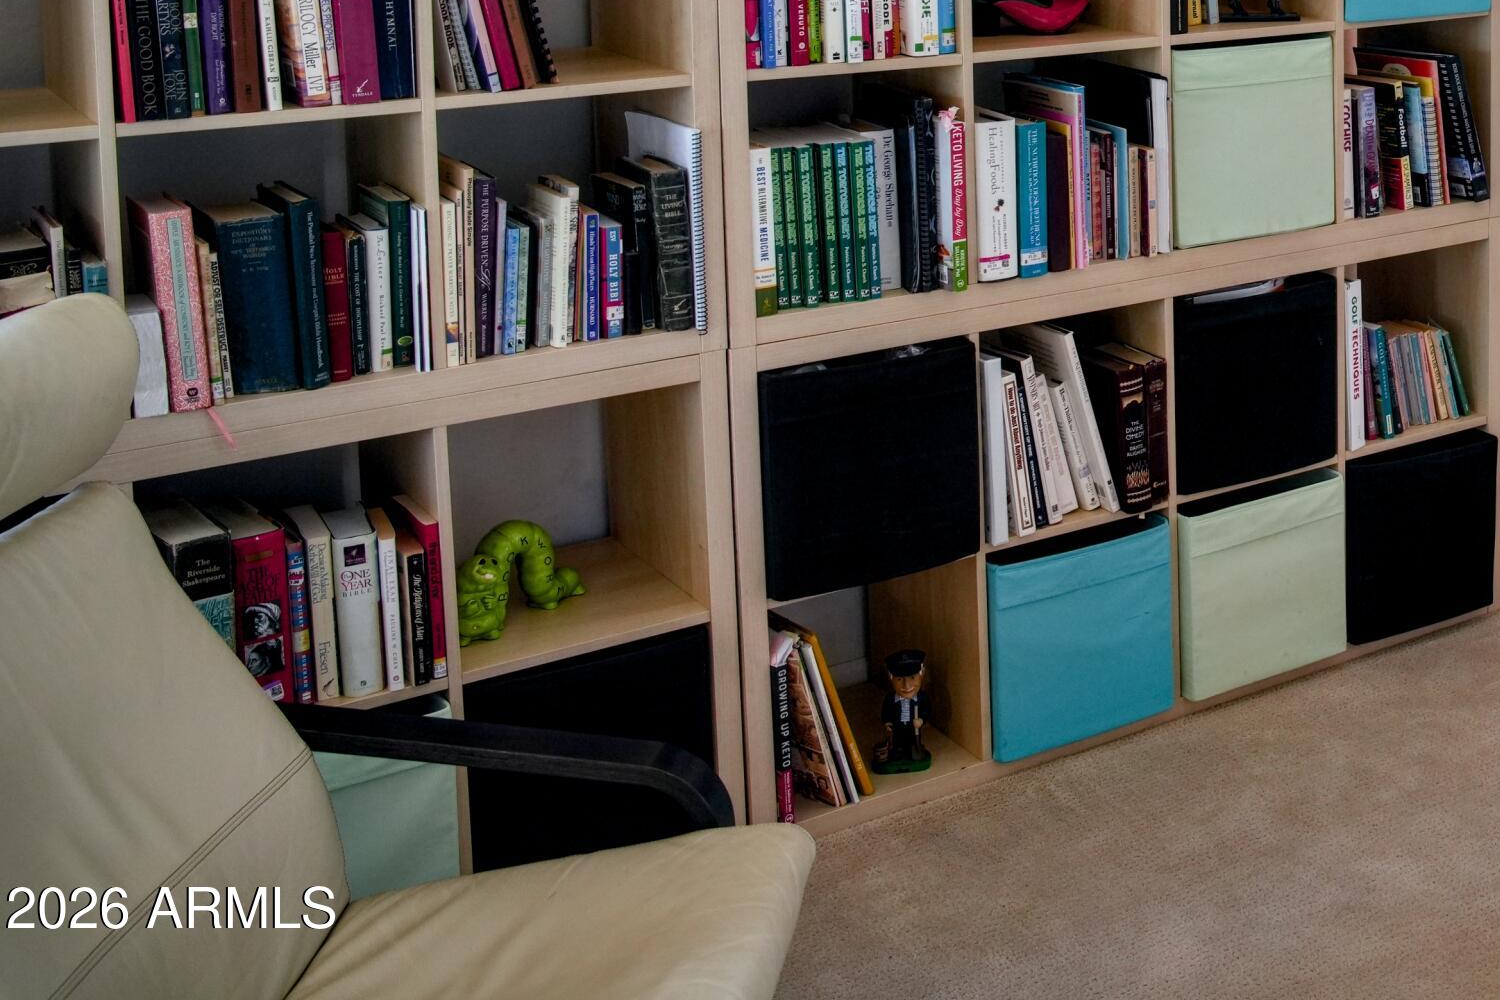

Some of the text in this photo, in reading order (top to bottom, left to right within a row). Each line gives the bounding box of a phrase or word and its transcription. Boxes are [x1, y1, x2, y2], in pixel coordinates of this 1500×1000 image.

[170, 2, 182, 33] BOOK
[323, 14, 334, 51] PROPHETS
[386, 1, 398, 51] HYMNAL
[798, 4, 806, 36] VENUTO
[137, 25, 154, 71] GOOD
[444, 24, 456, 50] BOOK
[304, 42, 320, 68] Miller
[142, 75, 157, 116] BOOK
[175, 69, 187, 101] JOHN
[309, 75, 324, 92] IVP
[1344, 106, 1352, 153] COCHISE
[1398, 108, 1408, 148] Football
[822, 148, 836, 242] THE TORTOISE DIET
[837, 146, 851, 240] THE TORTOISE DIET
[864, 144, 878, 238] THE TORTOISE DIET
[882, 136, 894, 222] Dr. George Sheehan
[952, 122, 964, 236] KETO LIVING Day by Day
[662, 202, 683, 210] LIVING
[800, 152, 814, 246] THE TORTOISE DIET
[1032, 188, 1040, 206] DESK
[480, 200, 490, 234] PURPOSE
[664, 210, 681, 218] BIBLE
[756, 167, 769, 262] BEST ALTERNATIVE MEDICINE
[324, 266, 342, 275] HOLY
[609, 254, 618, 278] HOLY
[211, 261, 227, 357] ADJUST SELF-DESTRUCT
[1352, 328, 1360, 400] TECHNIQUES
[1012, 429, 1020, 444] About
[1125, 424, 1144, 434] DIVINE
[1125, 430, 1145, 441] COMEDY
[1014, 445, 1023, 470] Anything
[187, 565, 220, 578] Riverside
[195, 558, 210, 566] The
[340, 568, 371, 582] ONE
[498, 536, 566, 601] BOOK WORM
[182, 572, 226, 588] Shakespeare
[341, 580, 372, 592] YEAR
[342, 588, 372, 598] BIBLE
[412, 574, 422, 616] The Religions
[318, 640, 331, 676] Friesen
[778, 668, 790, 720] GROWING
[780, 722, 790, 737] UP
[781, 740, 792, 768] KETO
